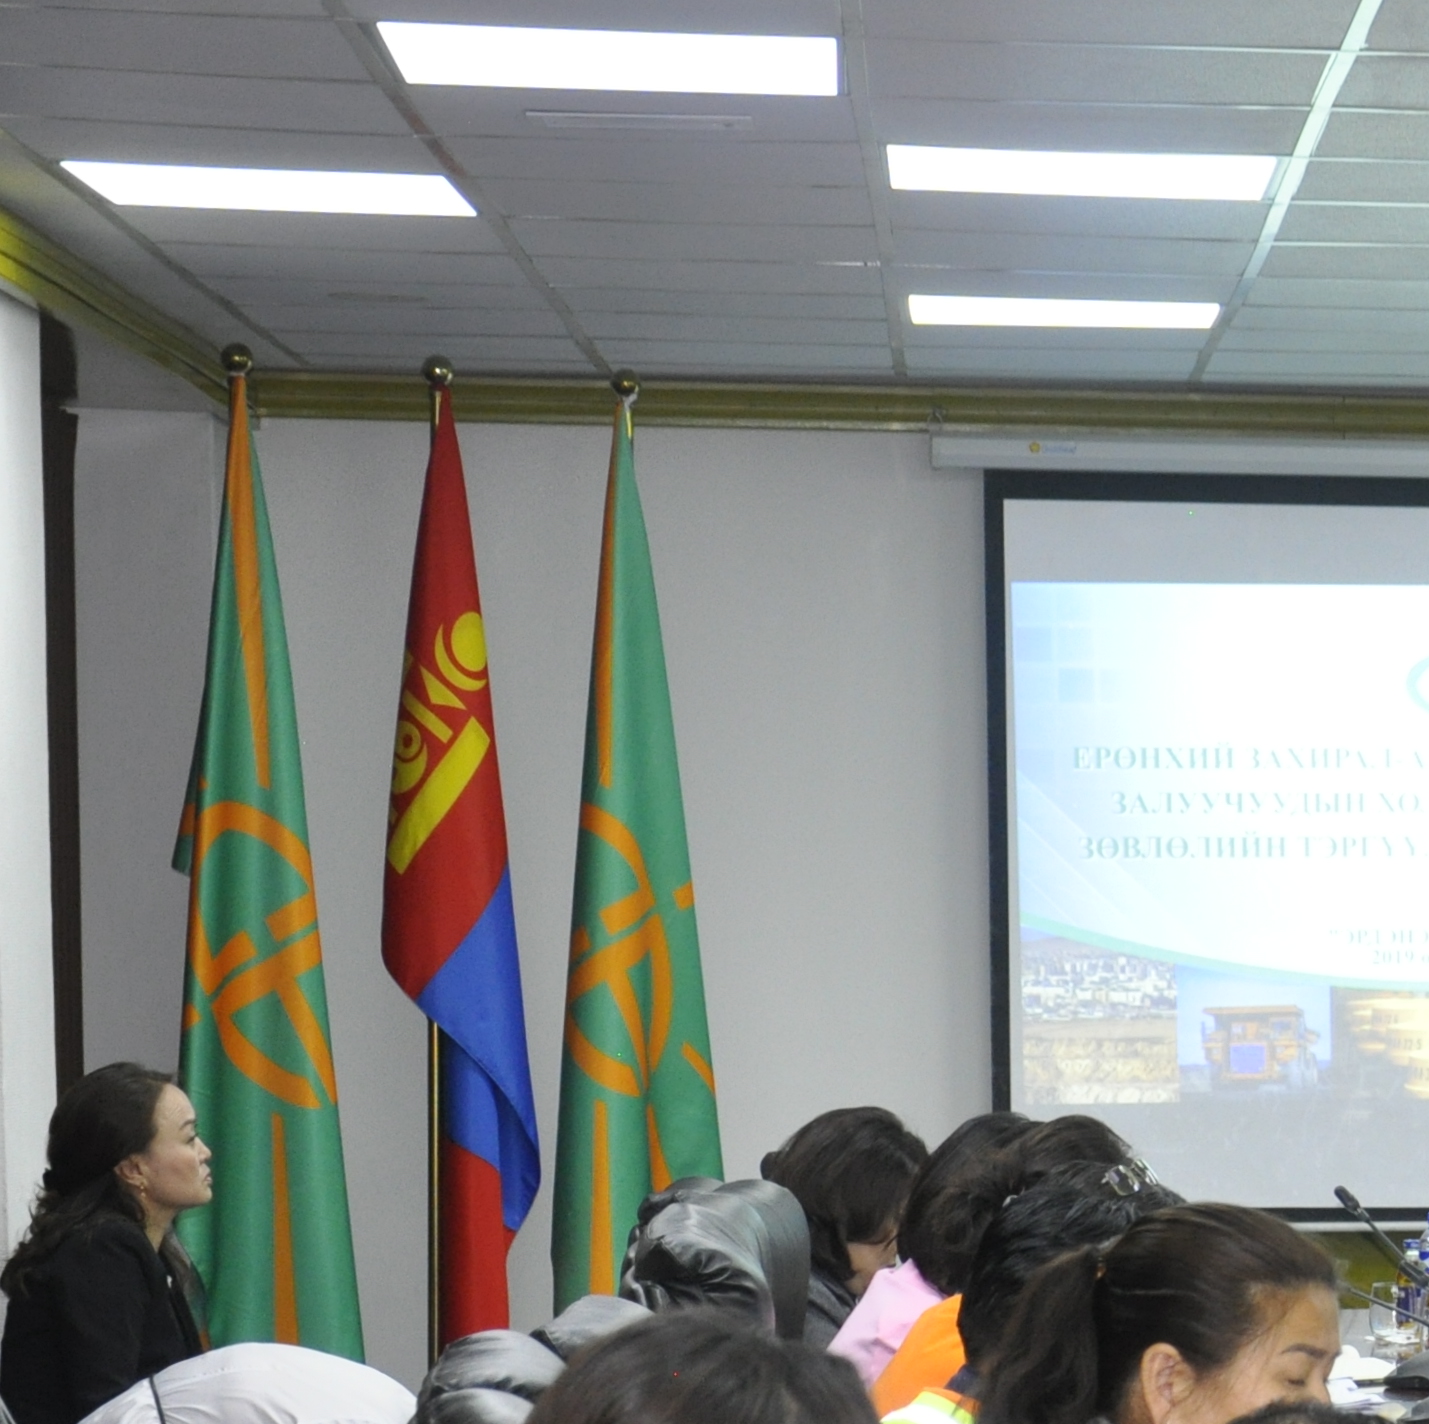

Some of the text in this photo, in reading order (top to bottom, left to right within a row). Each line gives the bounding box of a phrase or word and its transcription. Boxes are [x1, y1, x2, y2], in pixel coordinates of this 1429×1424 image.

[1072, 742, 1234, 770] ЕРӨНХИЙ
[1110, 791, 1365, 816] ЗАЛУУЧУУДЫН
[1077, 831, 1286, 859] ЗӨВЛӨЛИЙН
[1371, 948, 1415, 964] 2019
